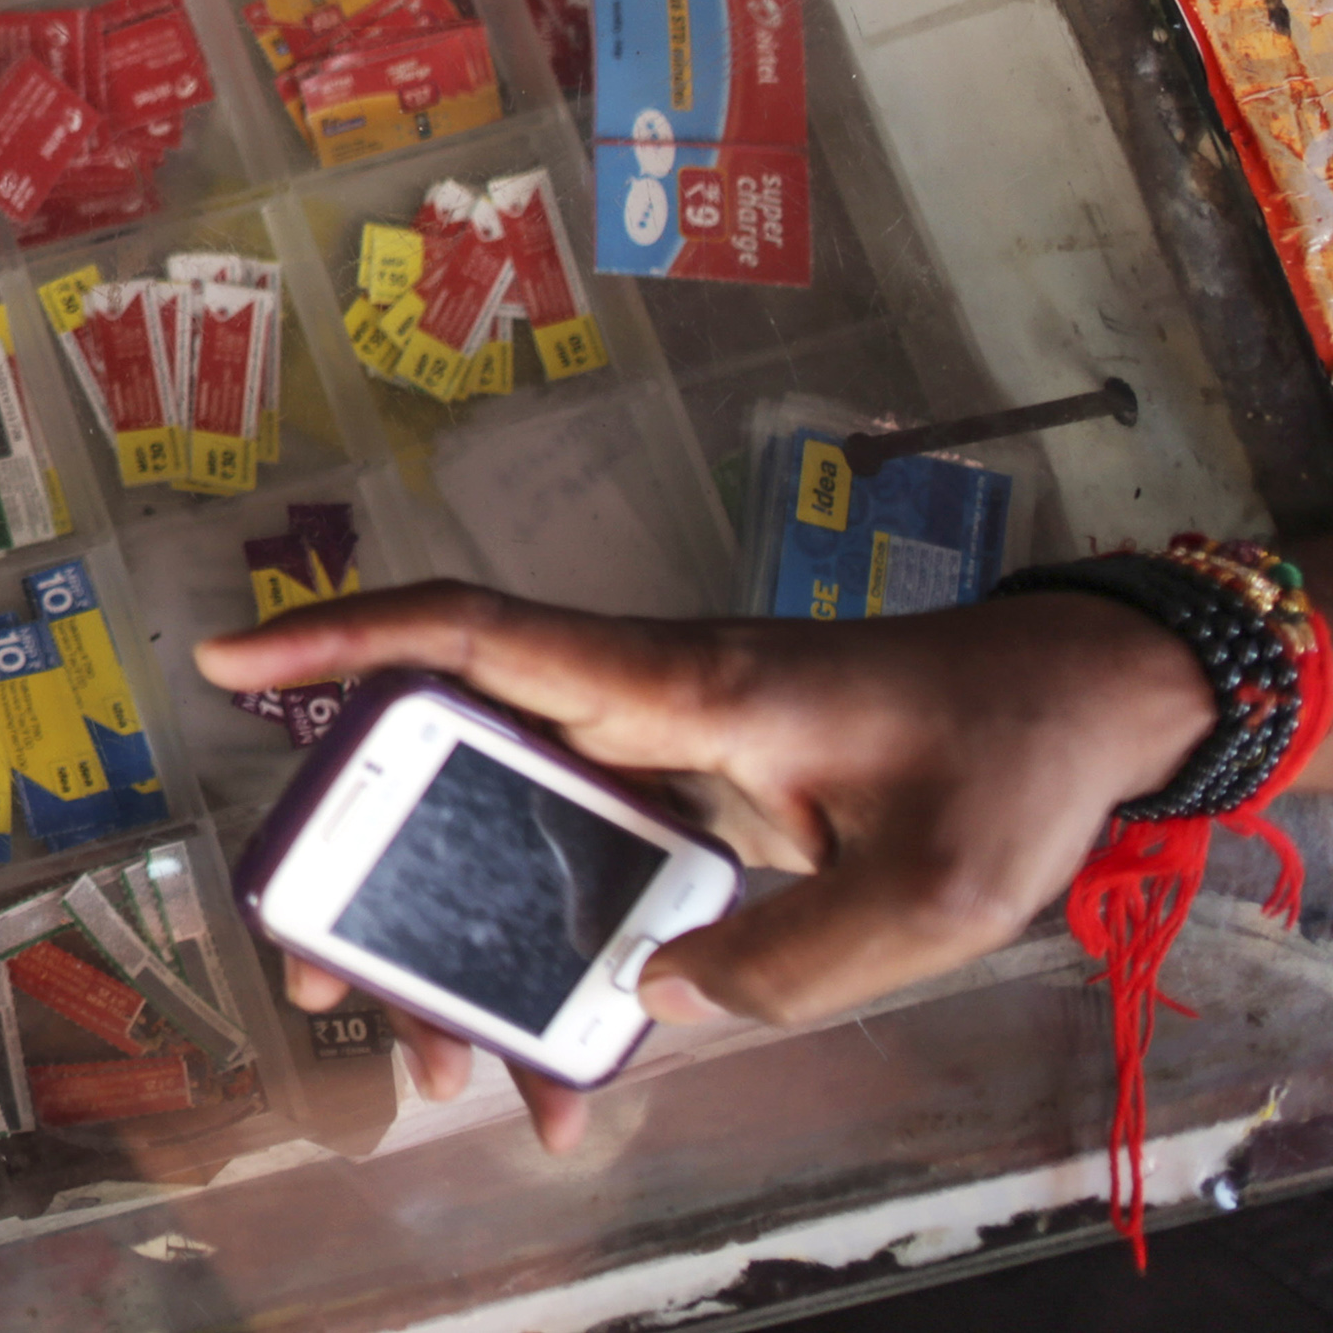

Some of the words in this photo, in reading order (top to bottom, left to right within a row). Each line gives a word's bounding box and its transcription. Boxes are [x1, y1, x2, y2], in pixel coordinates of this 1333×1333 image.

[754, 29, 778, 83] airtel
[732, 176, 759, 265] charge
[757, 174, 783, 247] super
[810, 457, 838, 516] idea
[36, 572, 72, 613] 10
